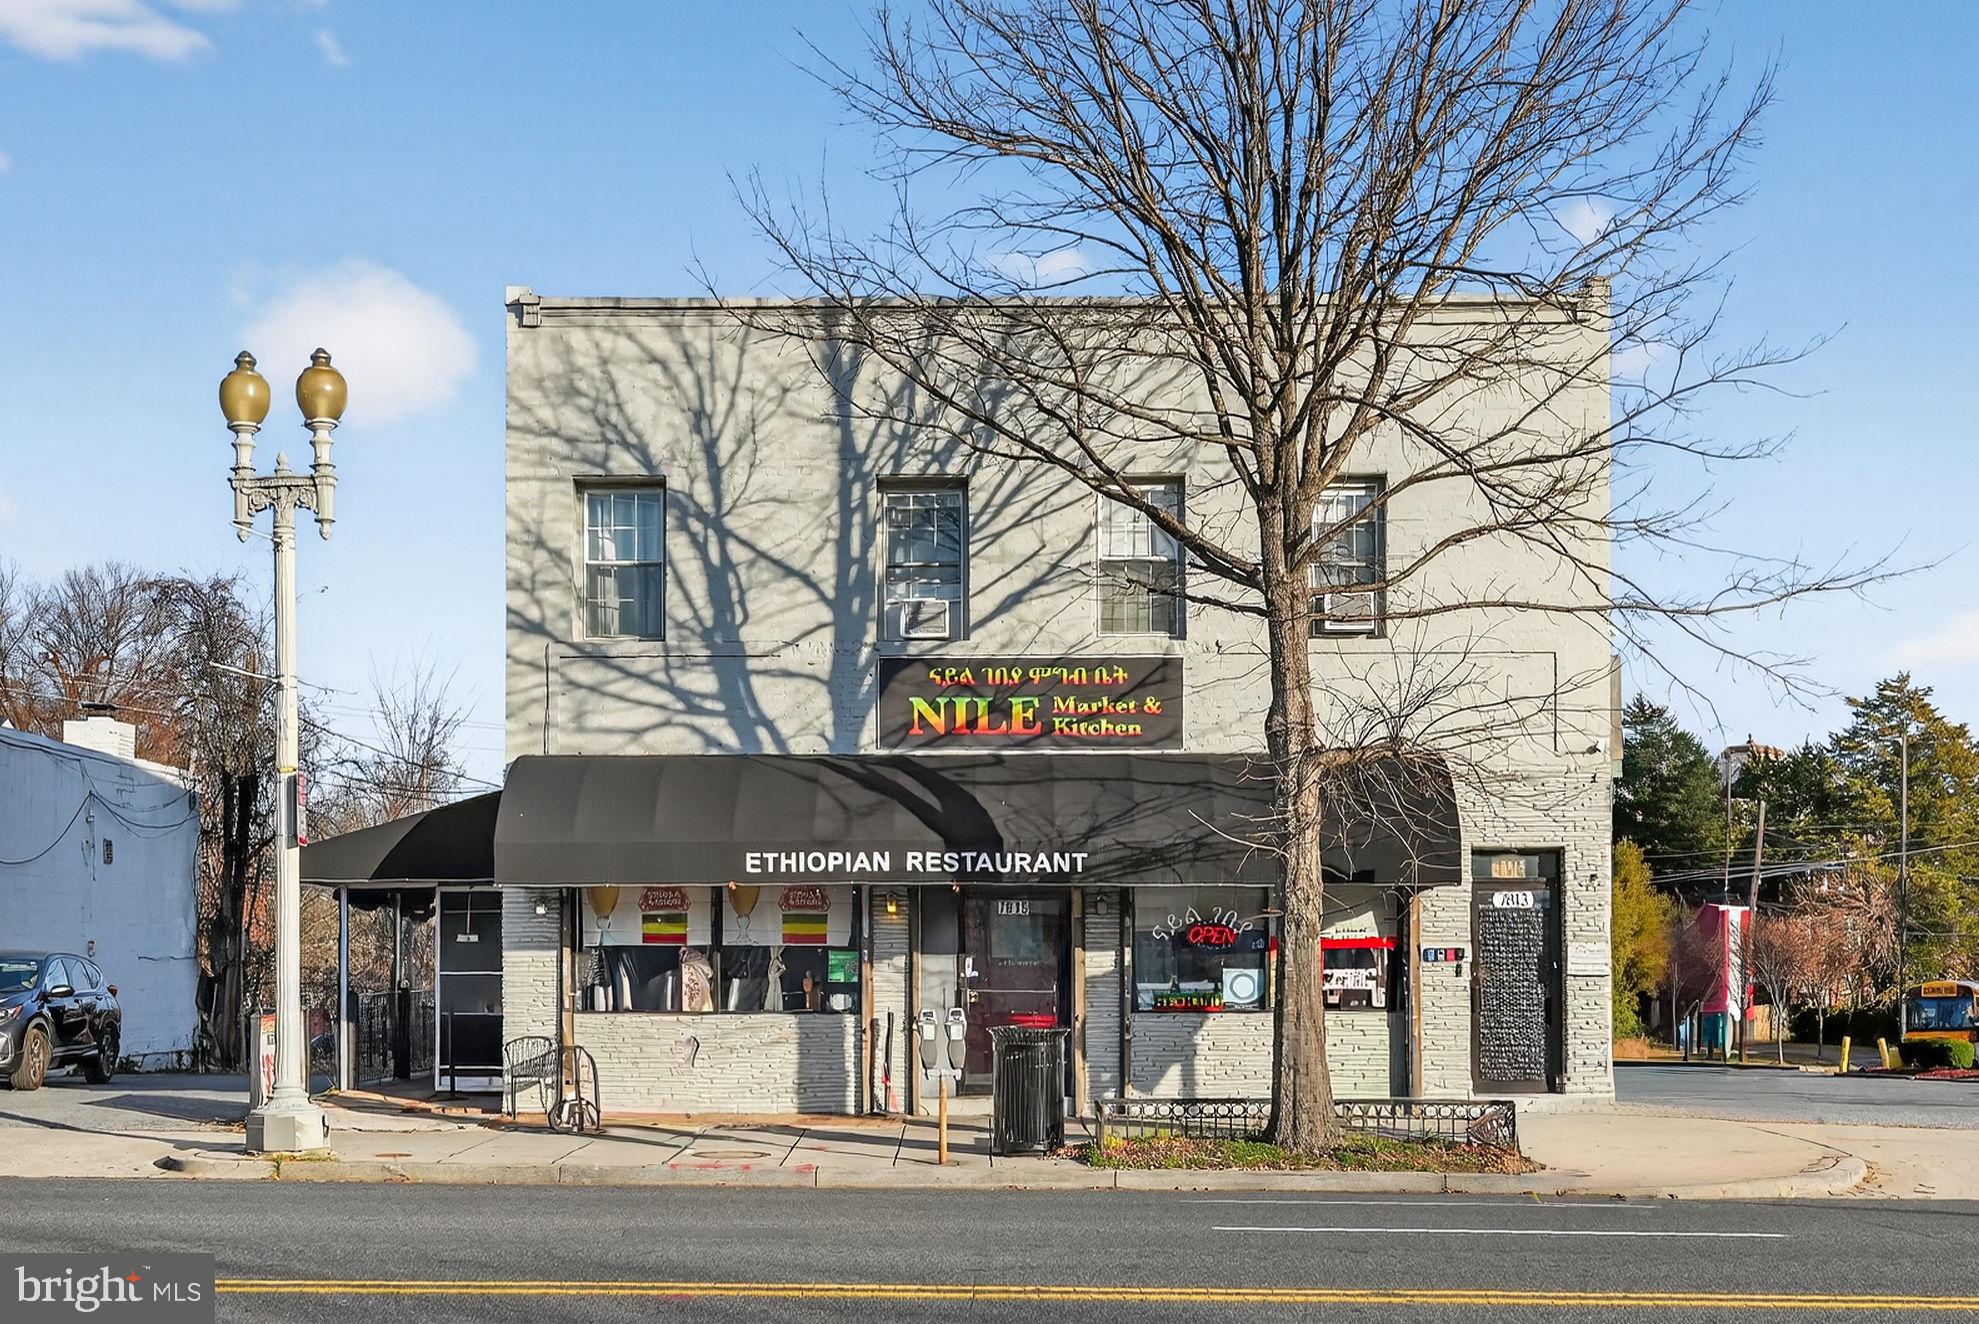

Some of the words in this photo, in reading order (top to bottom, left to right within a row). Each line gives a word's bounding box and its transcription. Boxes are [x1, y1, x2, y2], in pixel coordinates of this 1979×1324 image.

[1052, 696, 1138, 714] Market
[1143, 696, 1162, 714] &
[908, 696, 1042, 736] NILE
[1052, 717, 1142, 736] Kitchen
[745, 851, 890, 873] ETHIOPIAN
[906, 851, 1088, 873] RESTAURANT
[1189, 926, 1236, 944] OPEN
